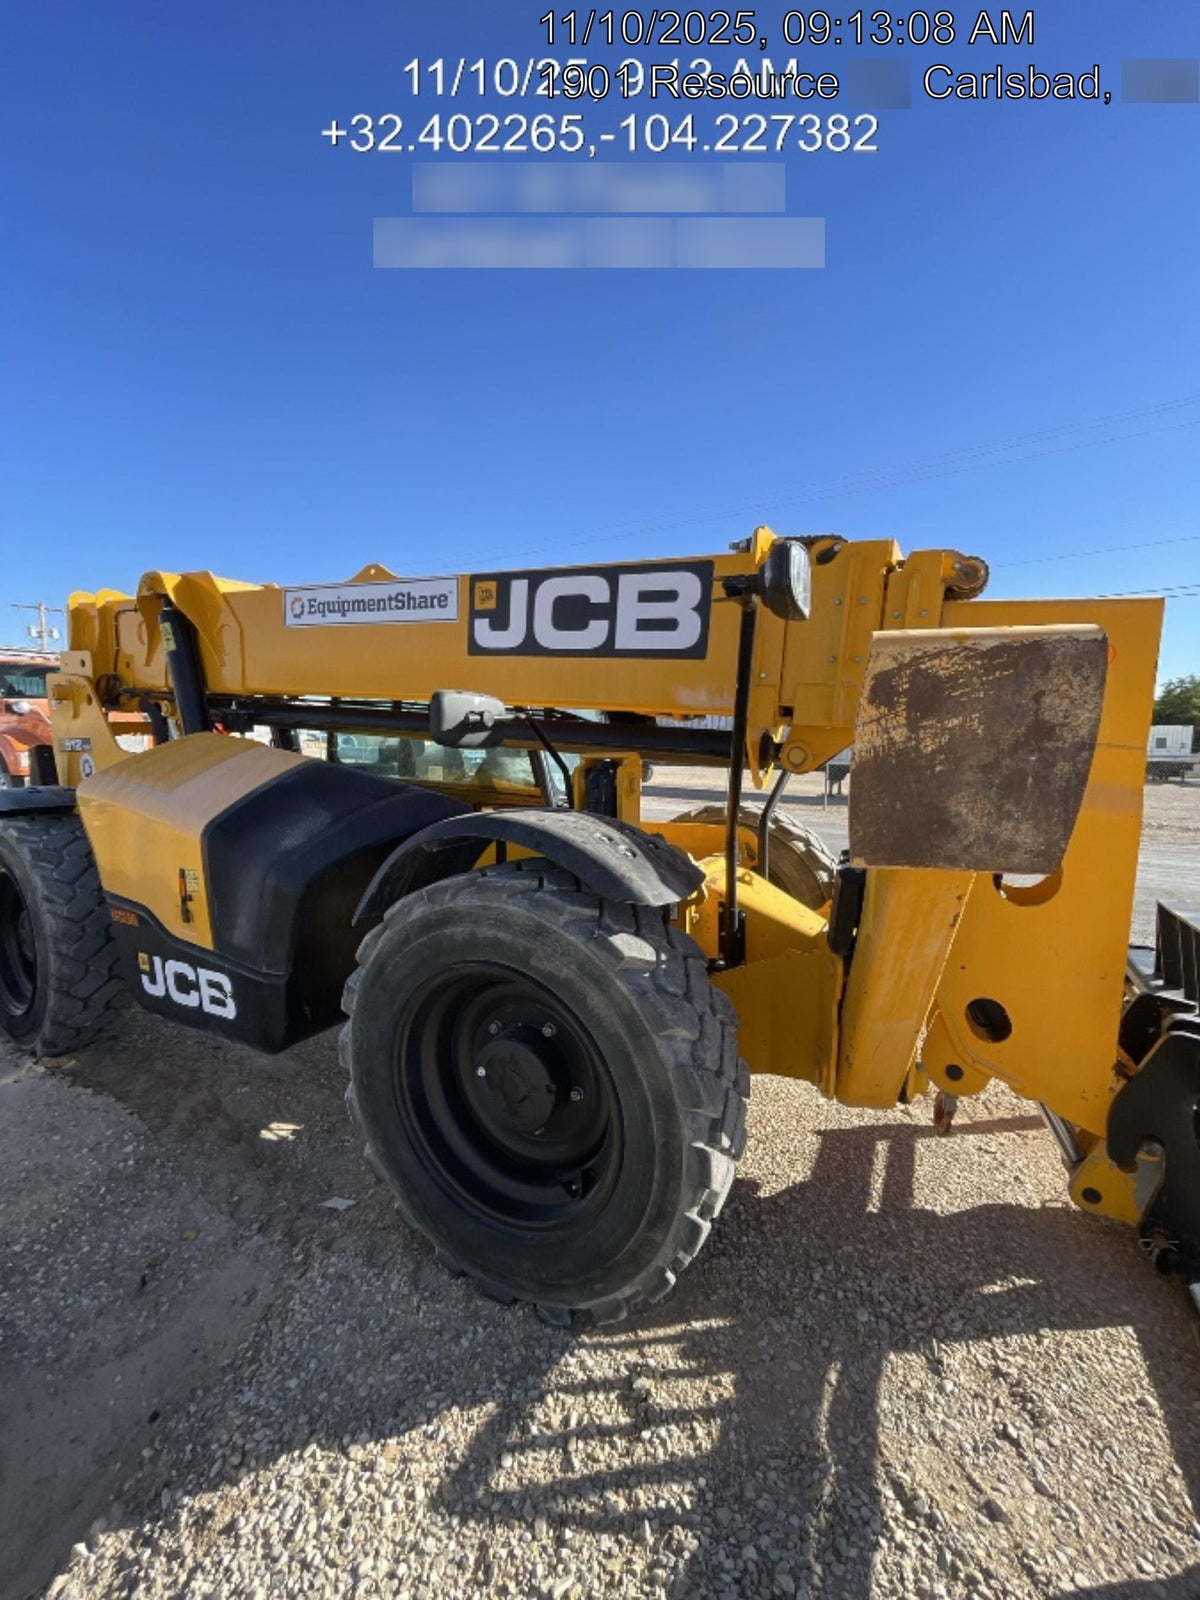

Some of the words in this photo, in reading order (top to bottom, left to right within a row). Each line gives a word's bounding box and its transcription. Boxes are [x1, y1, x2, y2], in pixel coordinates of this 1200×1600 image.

[306, 592, 449, 618] EquipmentShare
[474, 571, 702, 650] JCB
[141, 956, 237, 1020] JCB
